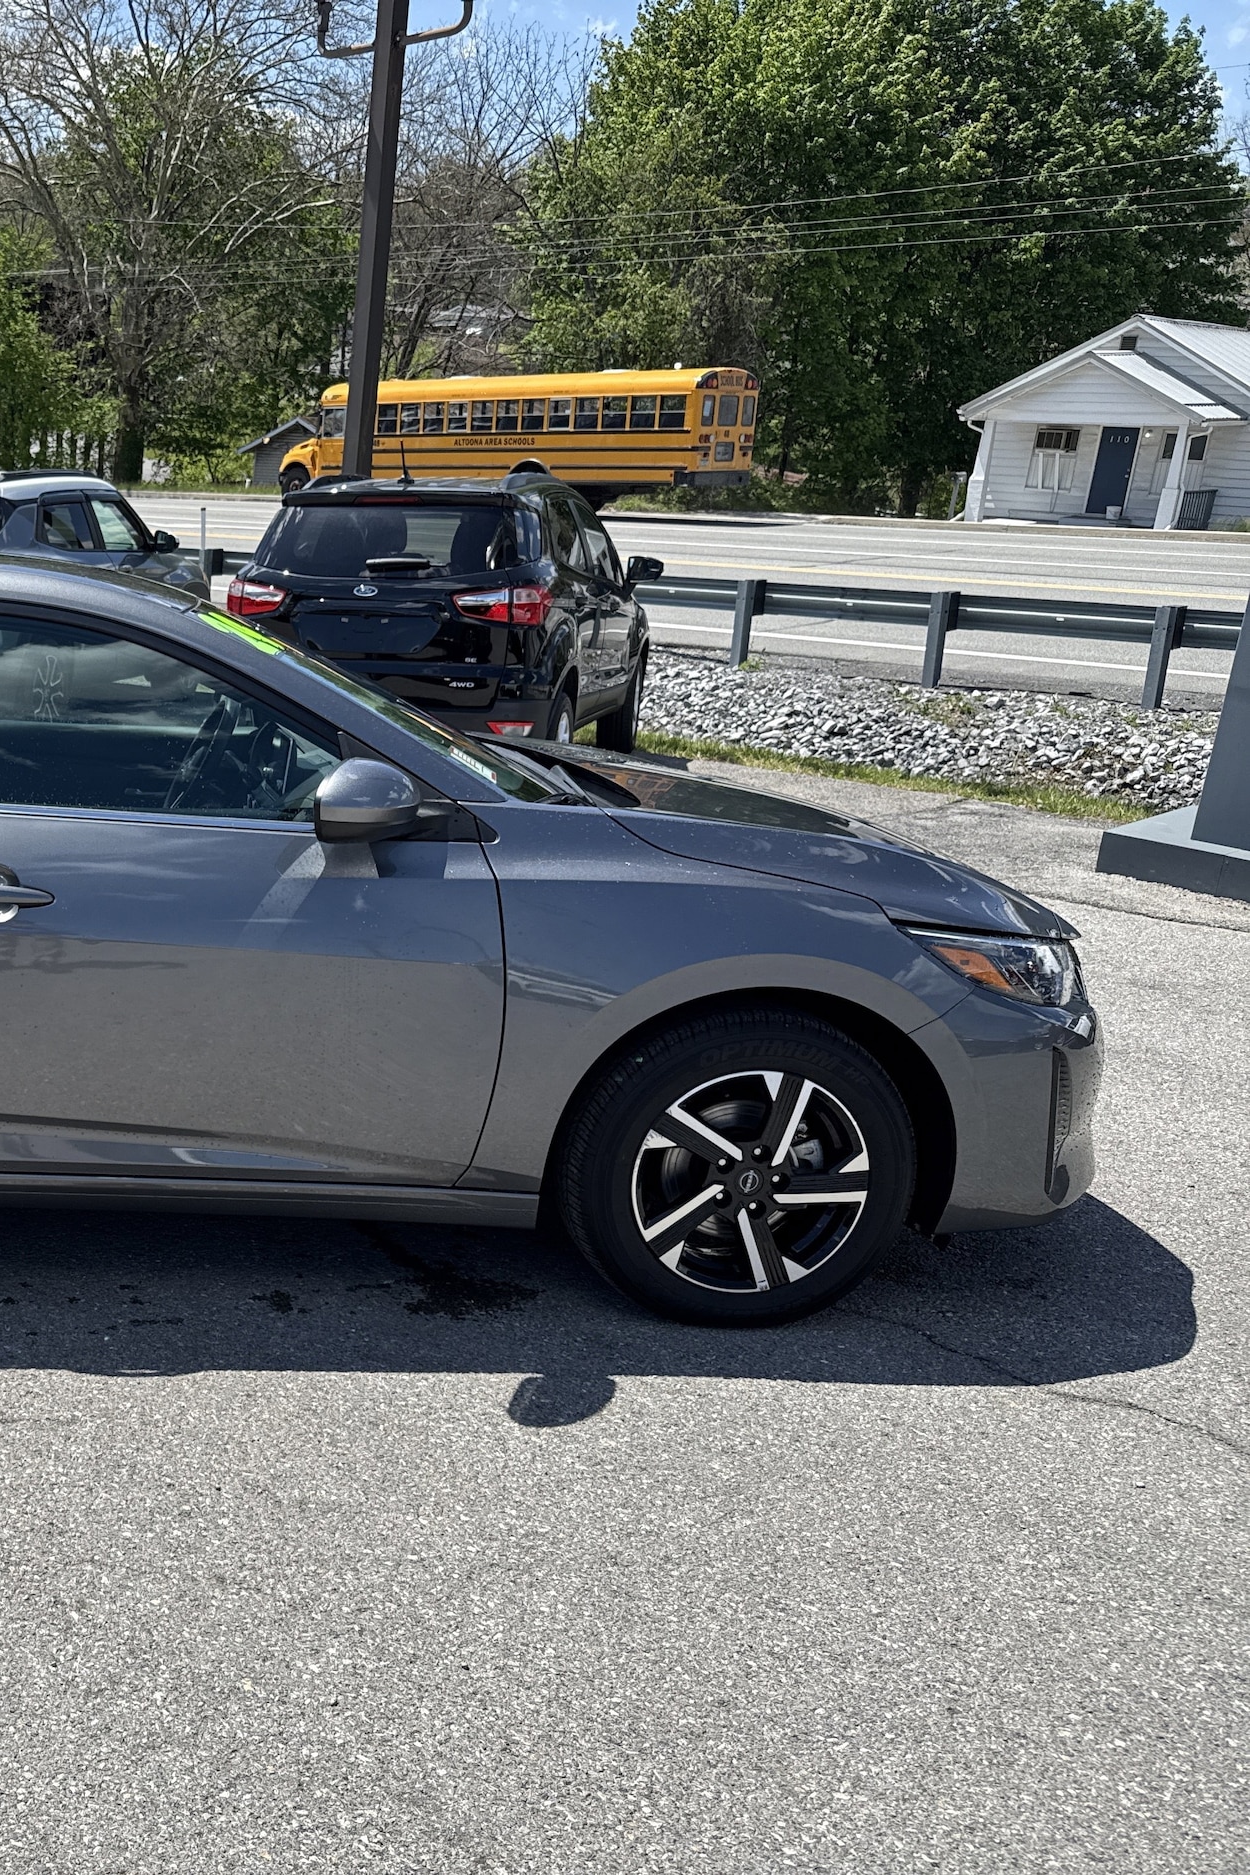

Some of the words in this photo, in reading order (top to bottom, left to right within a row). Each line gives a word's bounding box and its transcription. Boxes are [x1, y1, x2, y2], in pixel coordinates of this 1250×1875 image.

[454, 438, 483, 446] ALTOONA
[484, 438, 502, 446] AREA
[503, 437, 535, 446] SCHOOLS
[1110, 435, 1130, 443] 110
